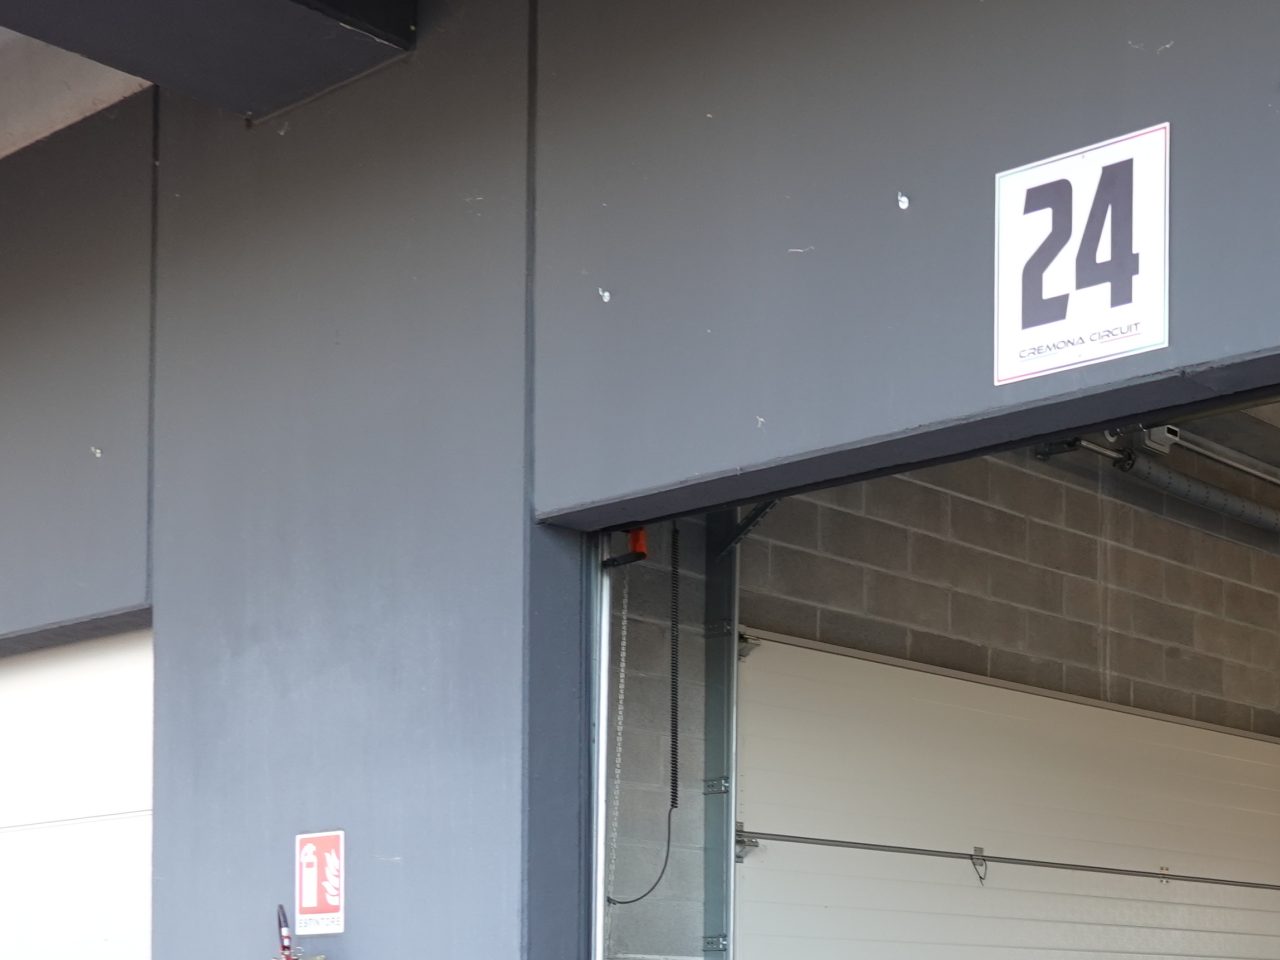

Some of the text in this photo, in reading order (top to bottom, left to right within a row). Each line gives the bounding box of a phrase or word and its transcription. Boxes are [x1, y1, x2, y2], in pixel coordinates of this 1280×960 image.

[1021, 157, 1139, 330] 24
[1018, 322, 1141, 359] CREMONA CIRCUIT
